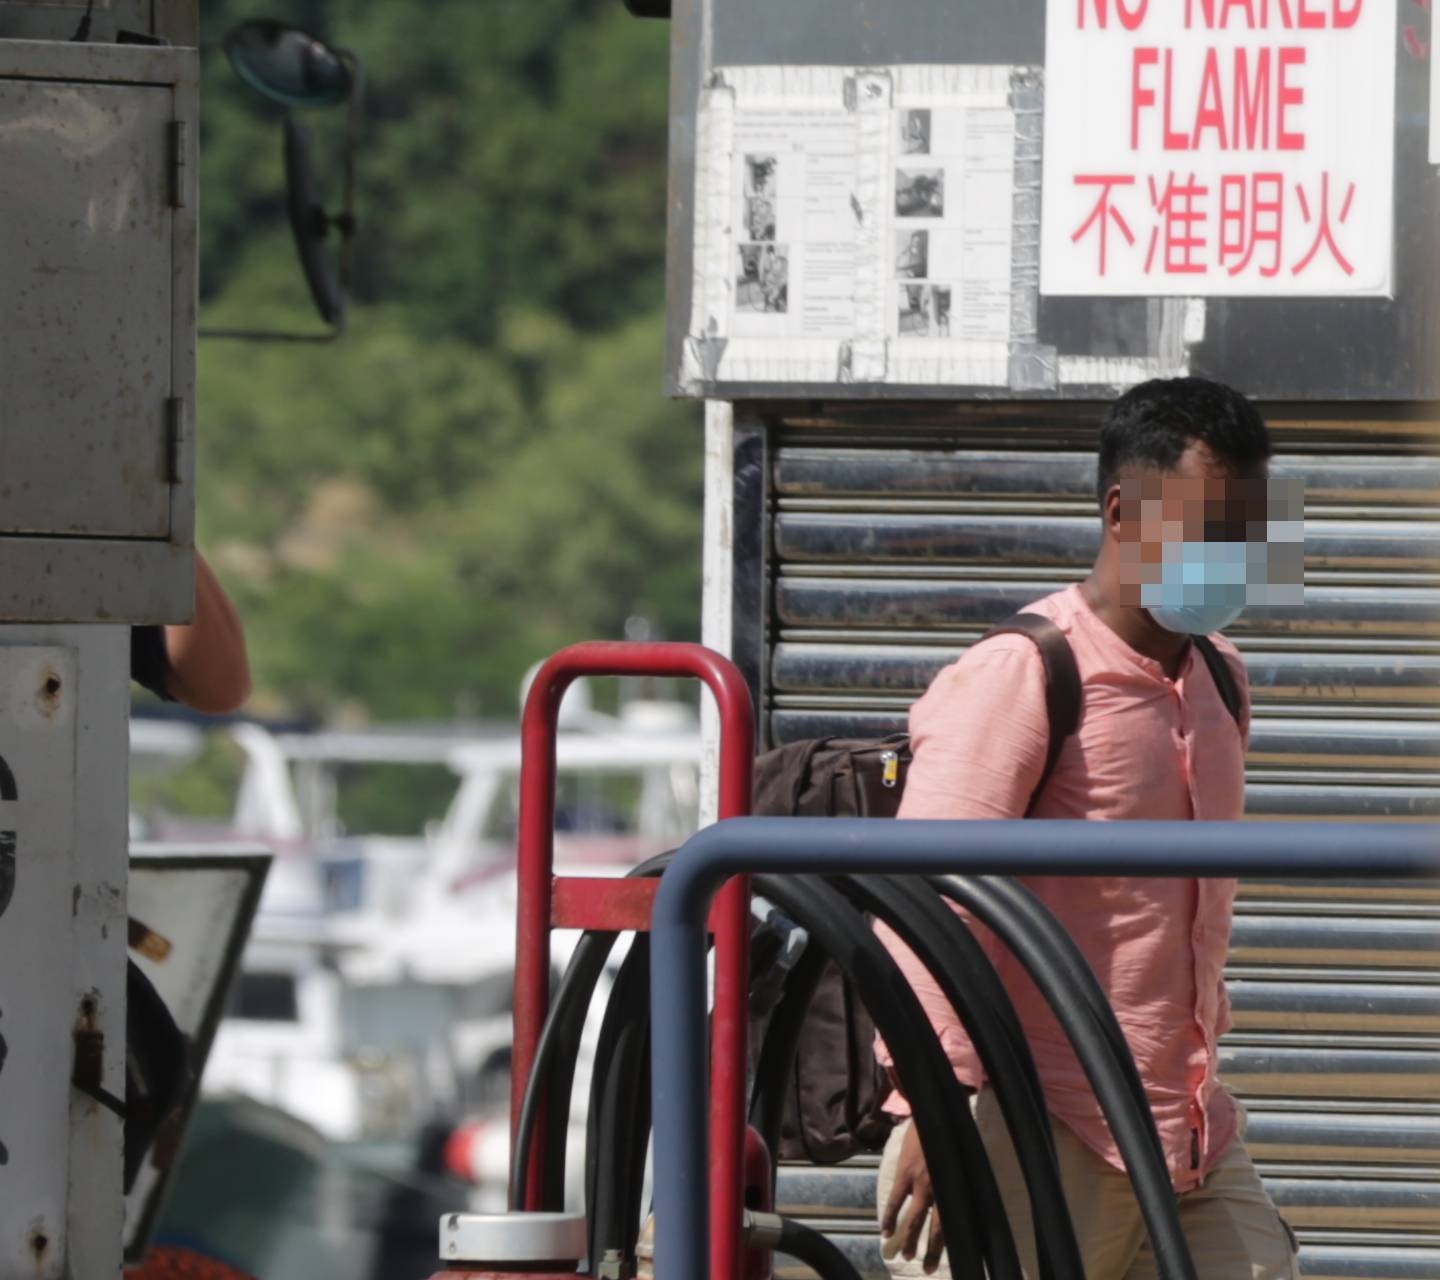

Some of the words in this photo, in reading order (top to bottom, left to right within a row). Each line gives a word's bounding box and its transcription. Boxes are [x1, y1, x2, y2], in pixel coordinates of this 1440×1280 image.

[1131, 46, 1306, 151] FLAME
[1072, 171, 1355, 278] 不准明火
